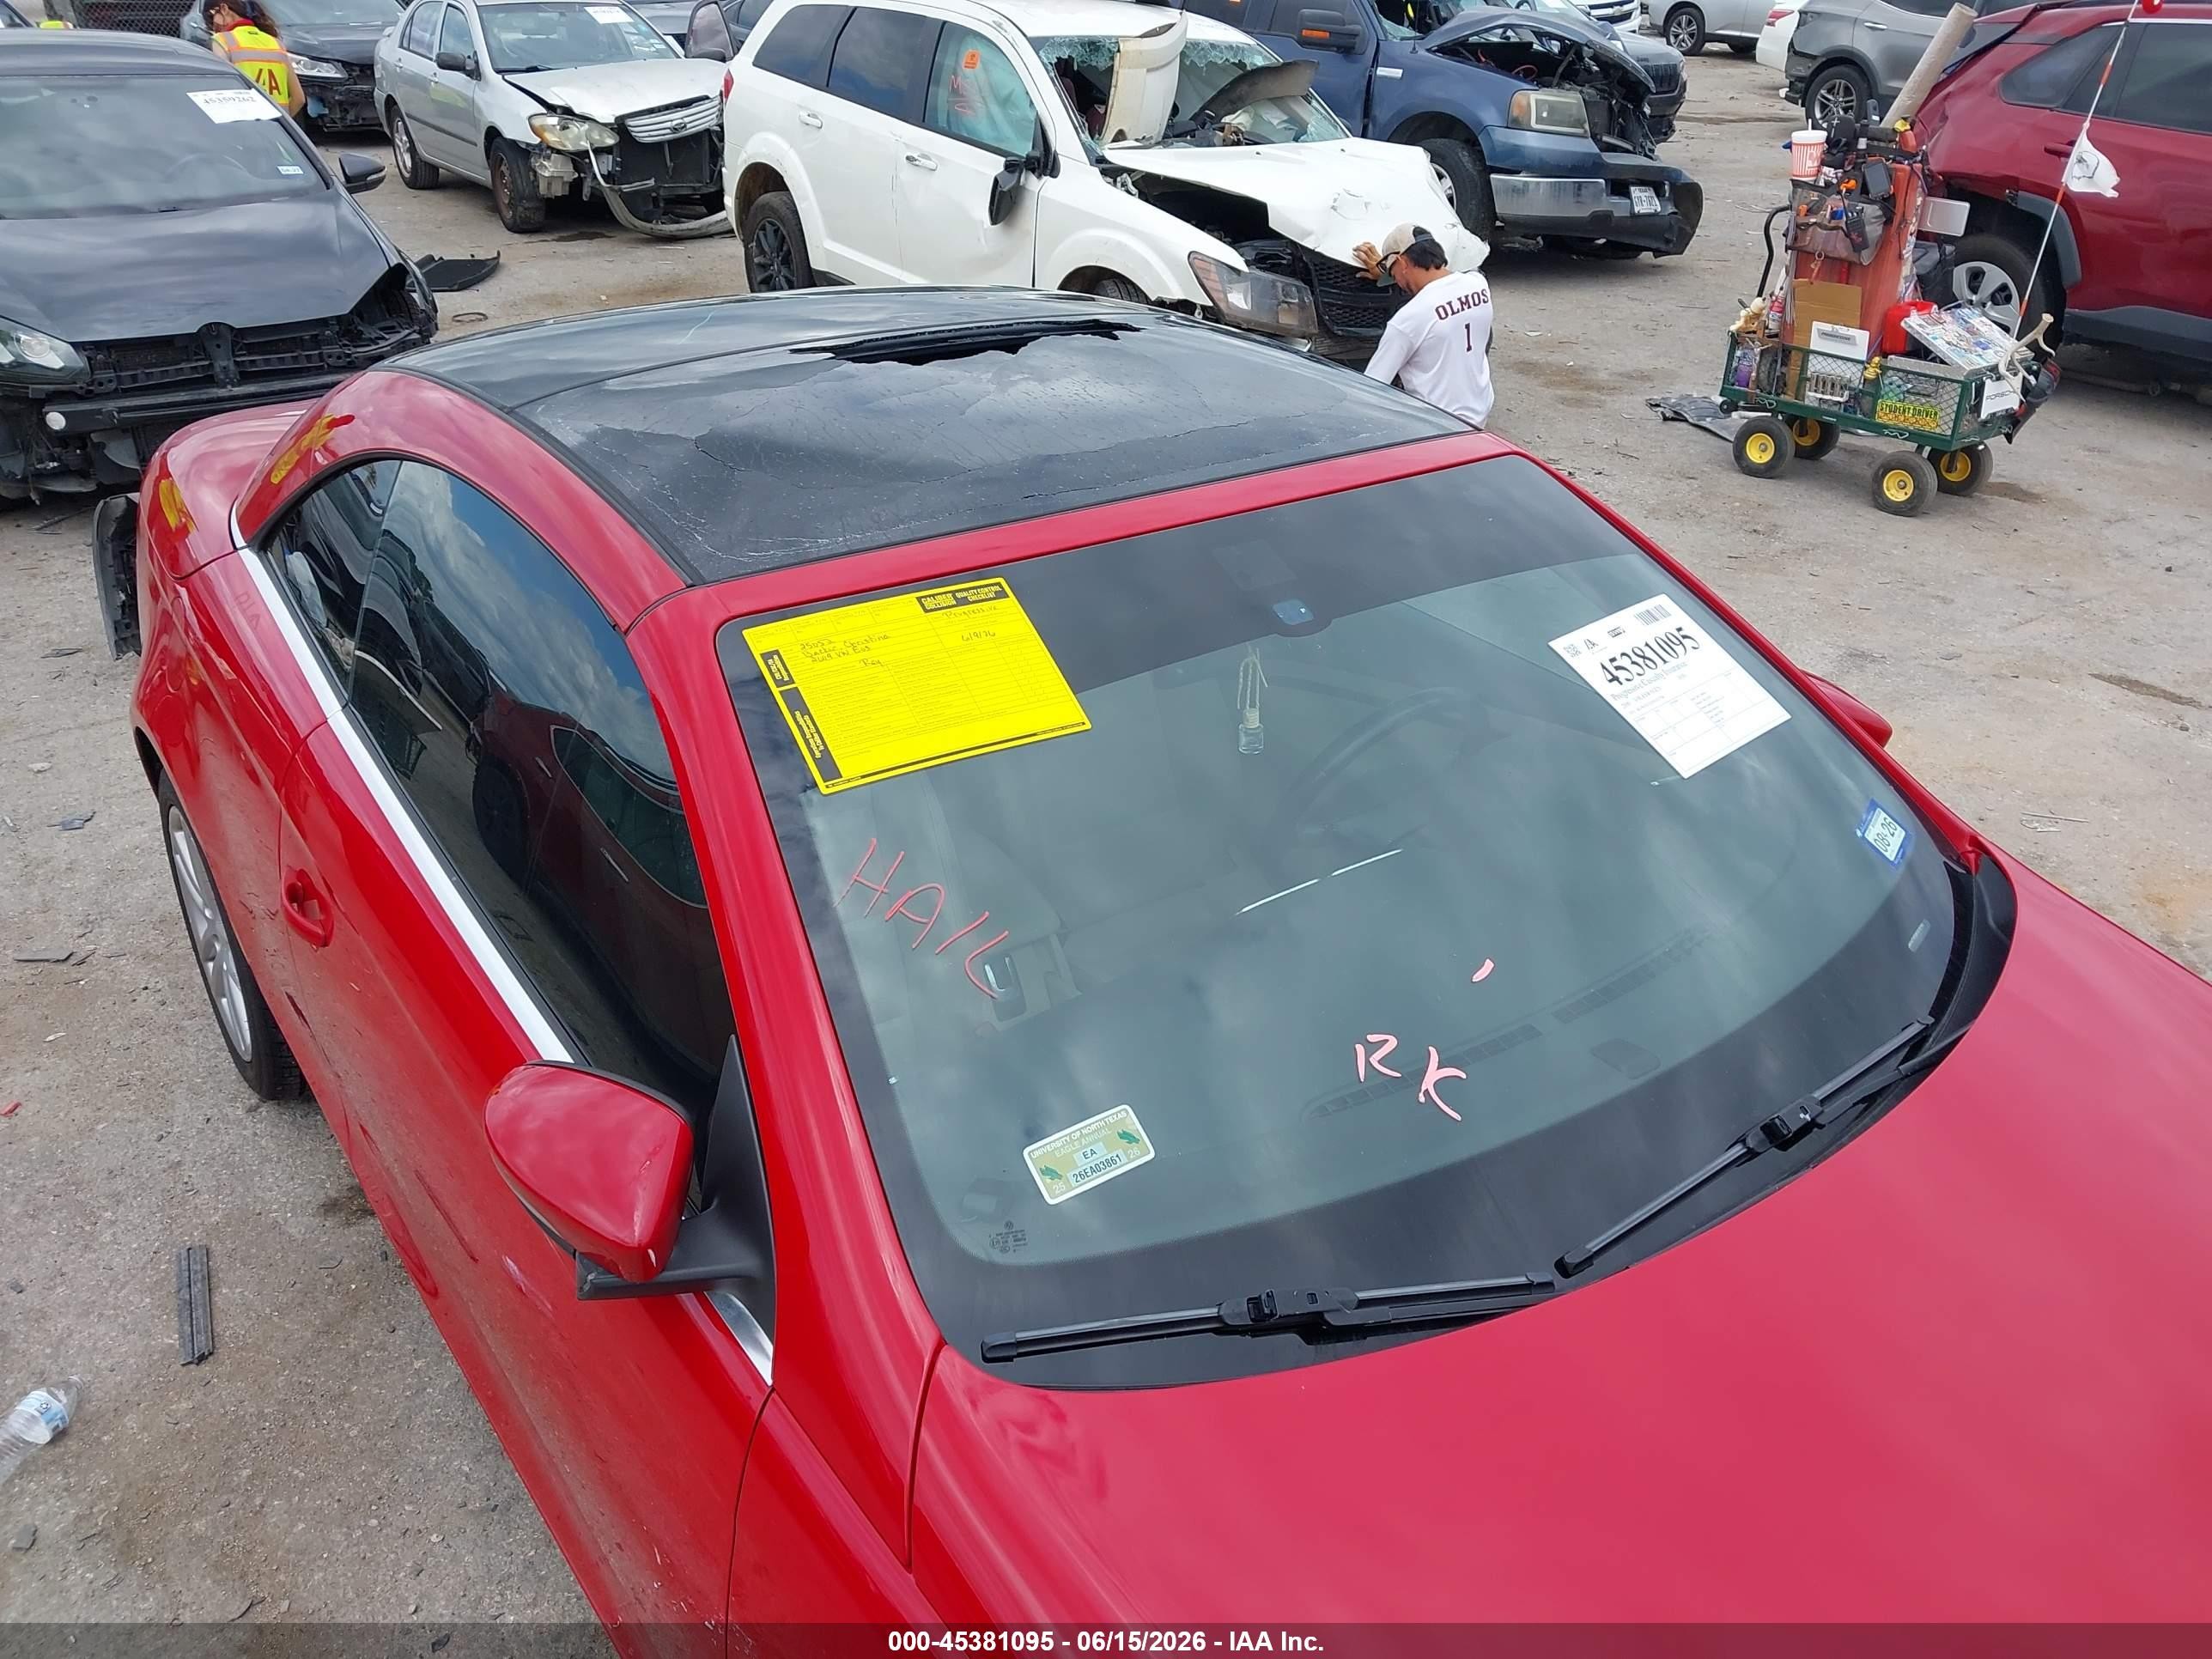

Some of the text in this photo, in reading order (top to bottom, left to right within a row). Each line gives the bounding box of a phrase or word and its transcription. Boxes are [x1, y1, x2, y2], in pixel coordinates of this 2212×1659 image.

[1435, 289, 1489, 320] OLMOS
[1464, 322, 1473, 353] 1
[1880, 403, 1938, 420] STUDENT DRIVER
[921, 592, 954, 605] CALIBER
[955, 585, 1003, 599] QUALITY CONTROL
[967, 592, 996, 602] CHECKLIST
[924, 599, 957, 610] COLLISION
[1600, 627, 1700, 685] 45381095
[833, 838, 1010, 1000] HAIL
[1030, 1110, 1127, 1159] UNIVERSITY OF NORTH TEXAS
[1054, 1127, 1113, 1158] EAGLE ANNUAL
[1082, 1148, 1097, 1160] EA
[1127, 1147, 1140, 1159] 26
[1073, 1153, 1123, 1183] 26EA03861
[1053, 1182, 1066, 1194] 25
